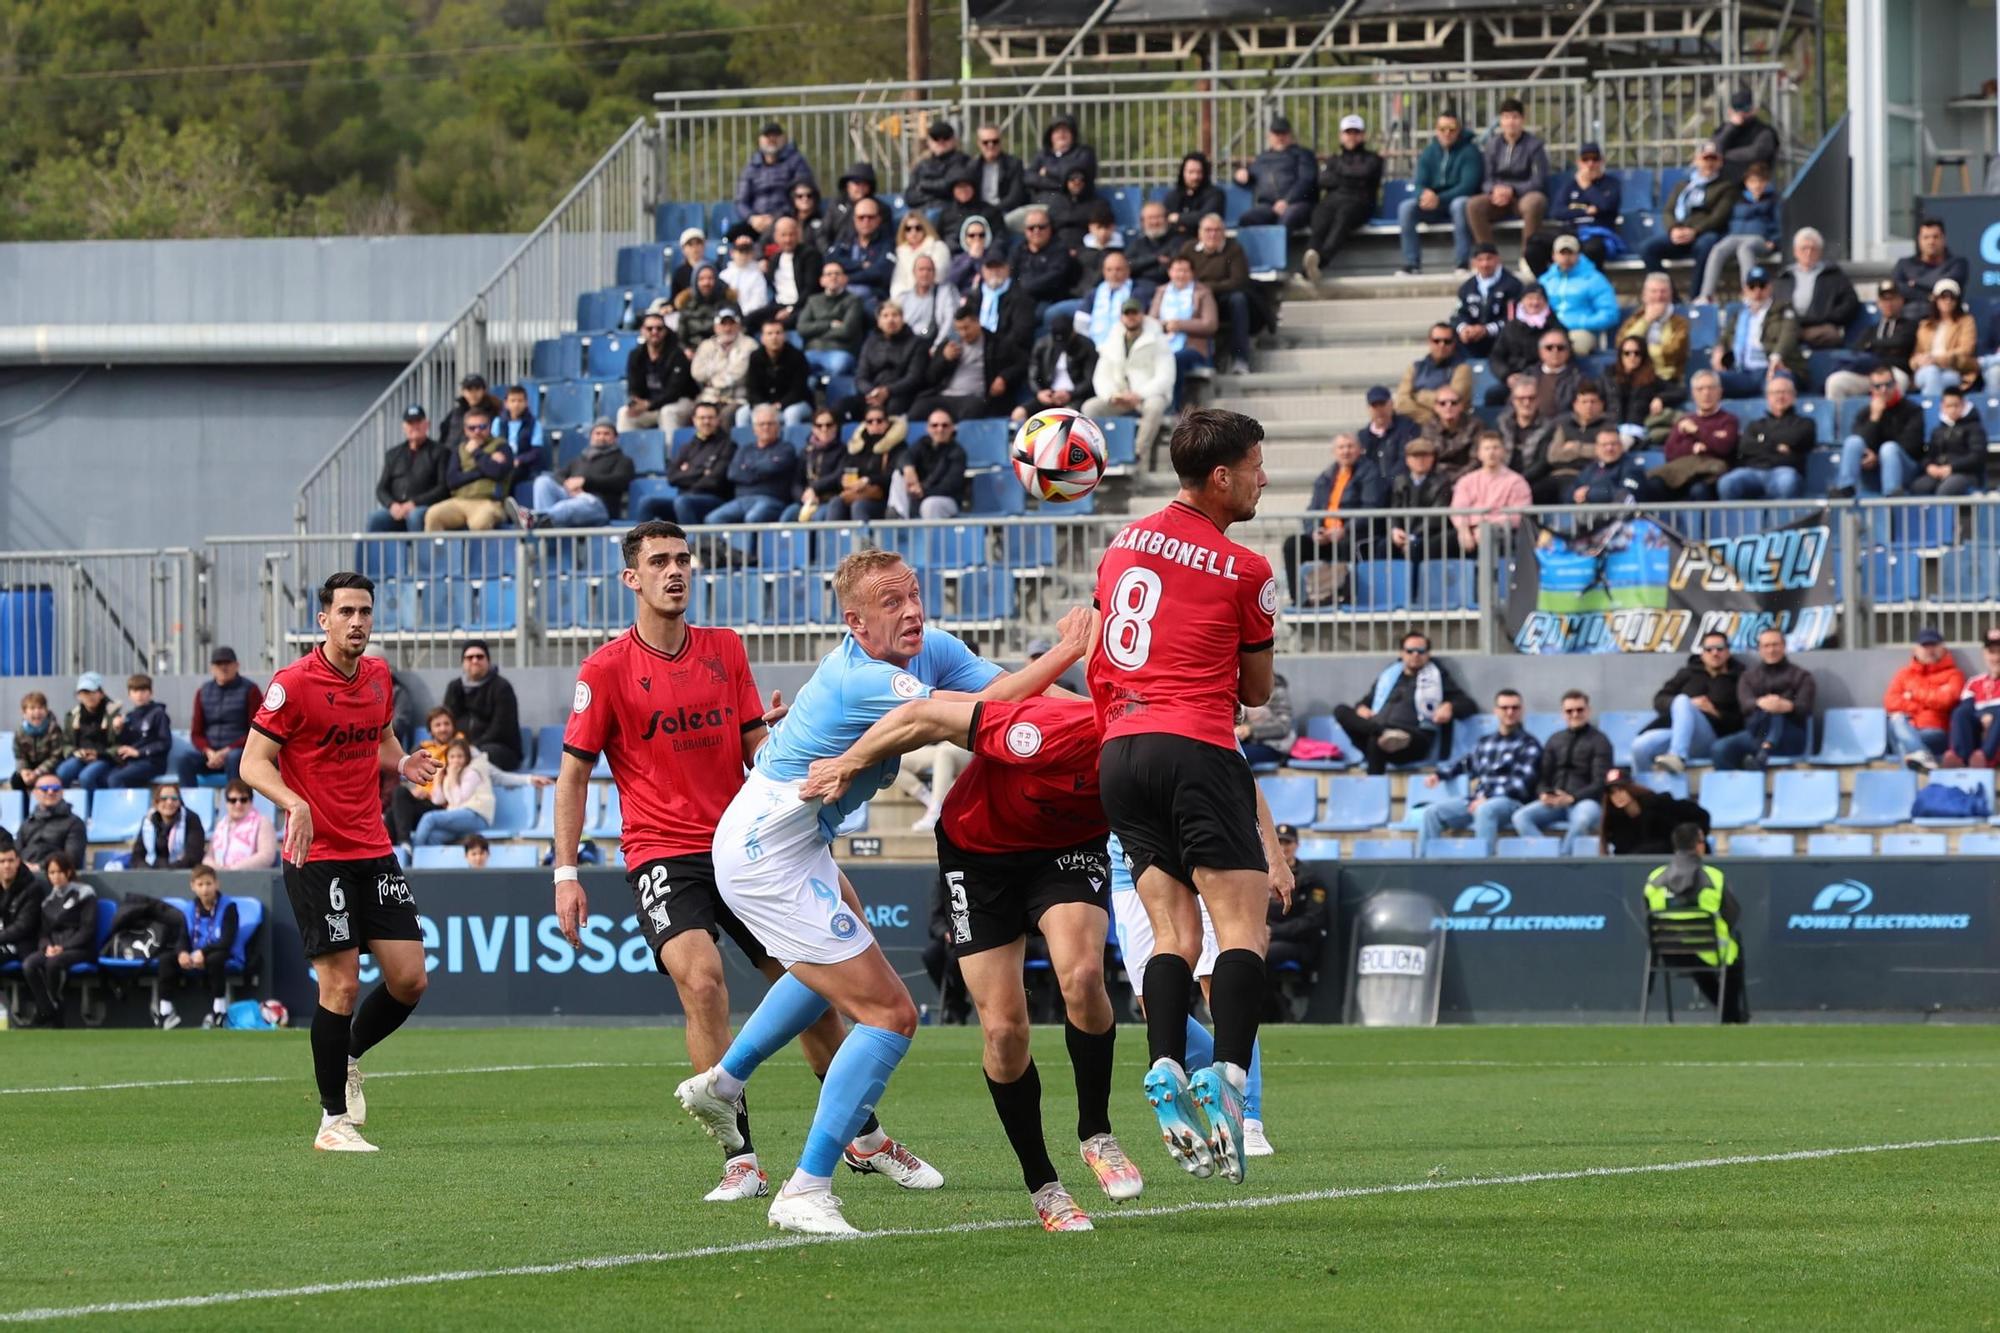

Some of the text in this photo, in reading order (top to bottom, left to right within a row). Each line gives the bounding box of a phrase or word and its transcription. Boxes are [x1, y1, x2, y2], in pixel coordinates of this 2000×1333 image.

[1103, 566, 1162, 671] 8
[329, 877, 346, 911] 6
[638, 865, 671, 910] 22
[945, 871, 968, 911] 5
[1430, 915, 1606, 930] POWER ELECTRONICS
[1788, 914, 1970, 929] POWER ELECTRONICS
